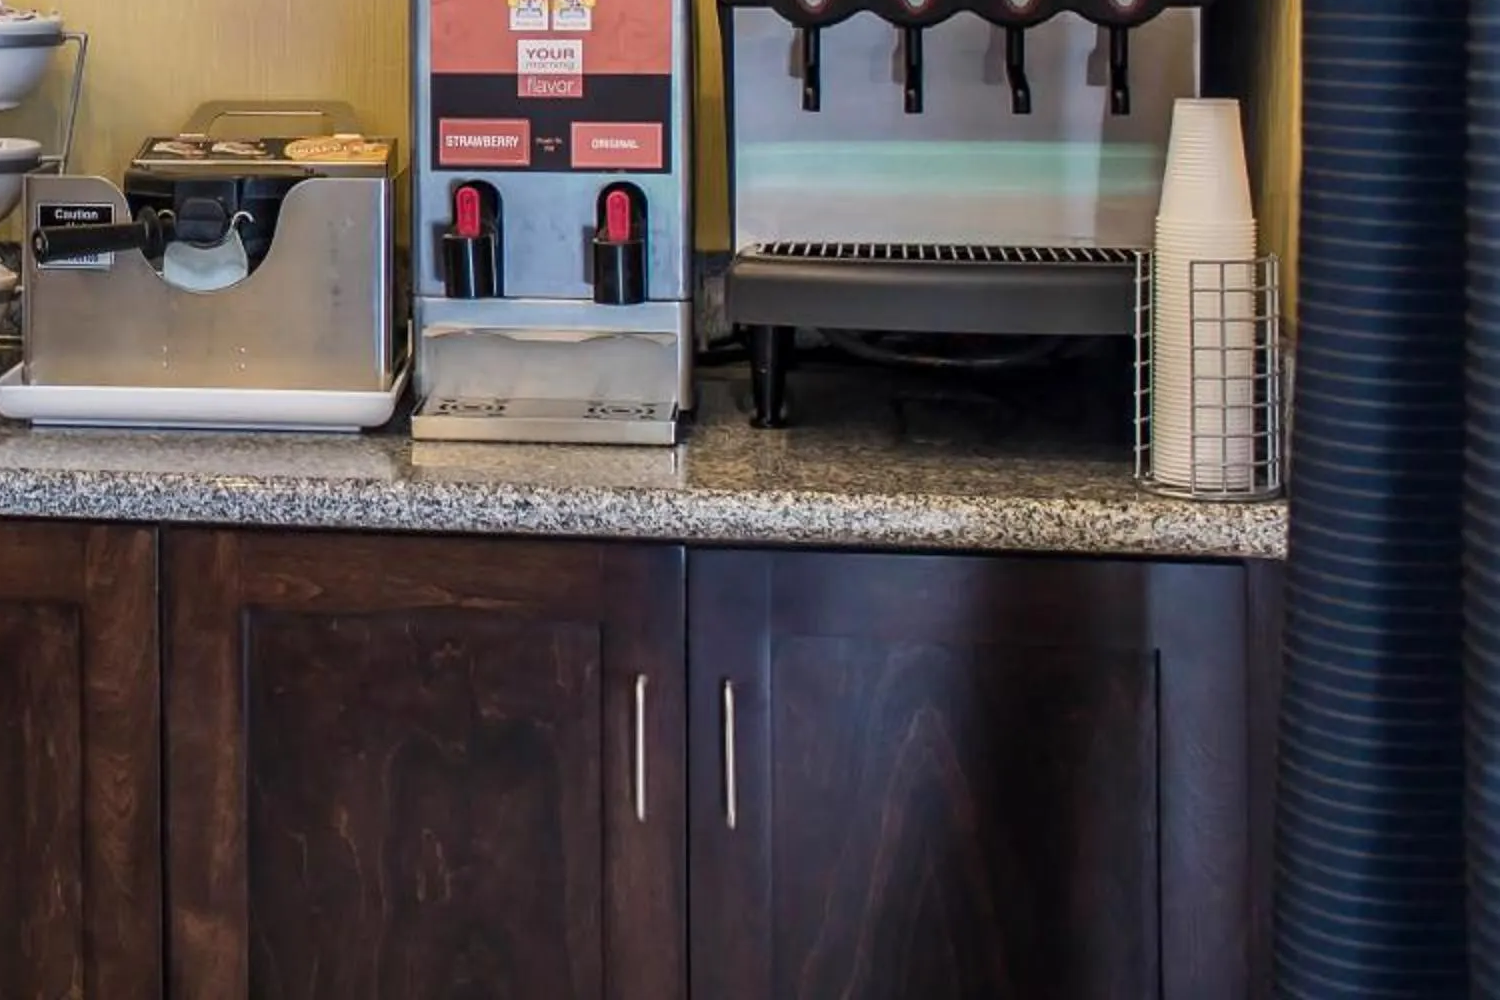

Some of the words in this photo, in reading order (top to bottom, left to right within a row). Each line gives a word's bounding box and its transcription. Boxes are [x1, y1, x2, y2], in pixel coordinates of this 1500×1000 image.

[525, 47, 575, 60] YOUR
[525, 60, 575, 72] morning
[527, 77, 574, 94] flavor
[446, 135, 519, 148] STRAWBERRY
[591, 138, 639, 149] ORIGINAL
[54, 208, 99, 220] Caution
